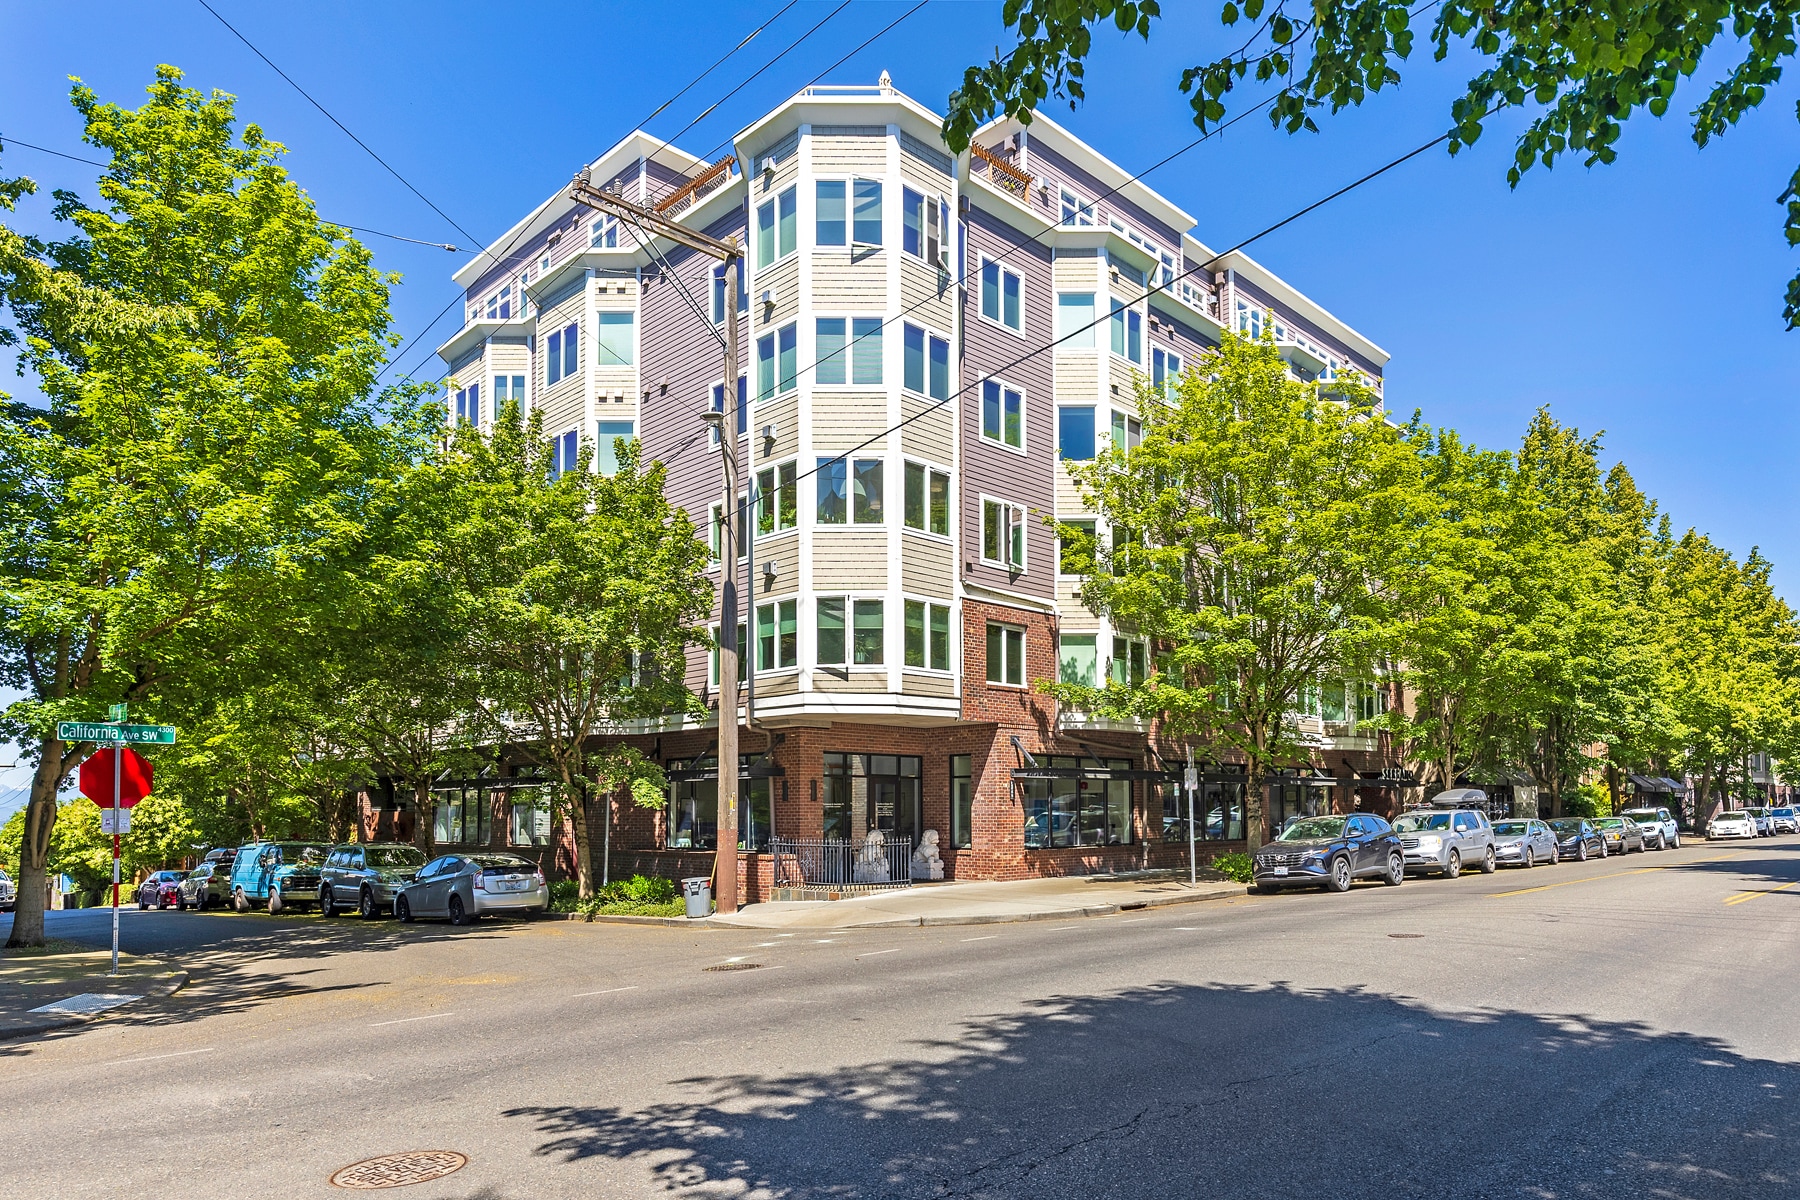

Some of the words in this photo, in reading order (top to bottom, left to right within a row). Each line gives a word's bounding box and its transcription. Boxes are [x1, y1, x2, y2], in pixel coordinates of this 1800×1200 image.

[60, 723, 118, 739] California
[120, 730, 139, 740] Ave
[141, 730, 157, 741] SW
[157, 726, 174, 734] 4300
